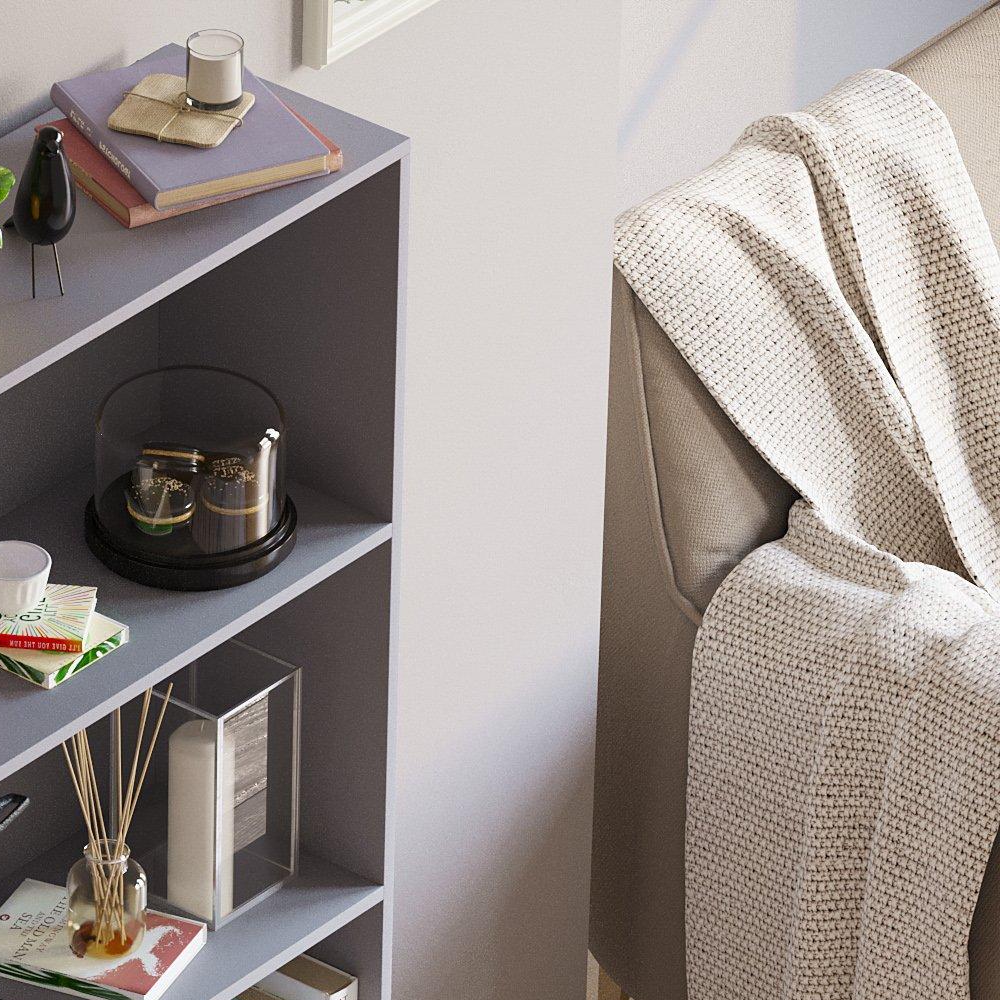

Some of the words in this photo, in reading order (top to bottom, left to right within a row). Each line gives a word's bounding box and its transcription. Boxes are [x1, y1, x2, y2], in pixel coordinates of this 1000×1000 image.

[10, 912, 33, 930] SEA
[32, 916, 56, 937] OLD
[12, 937, 37, 961] MAN
